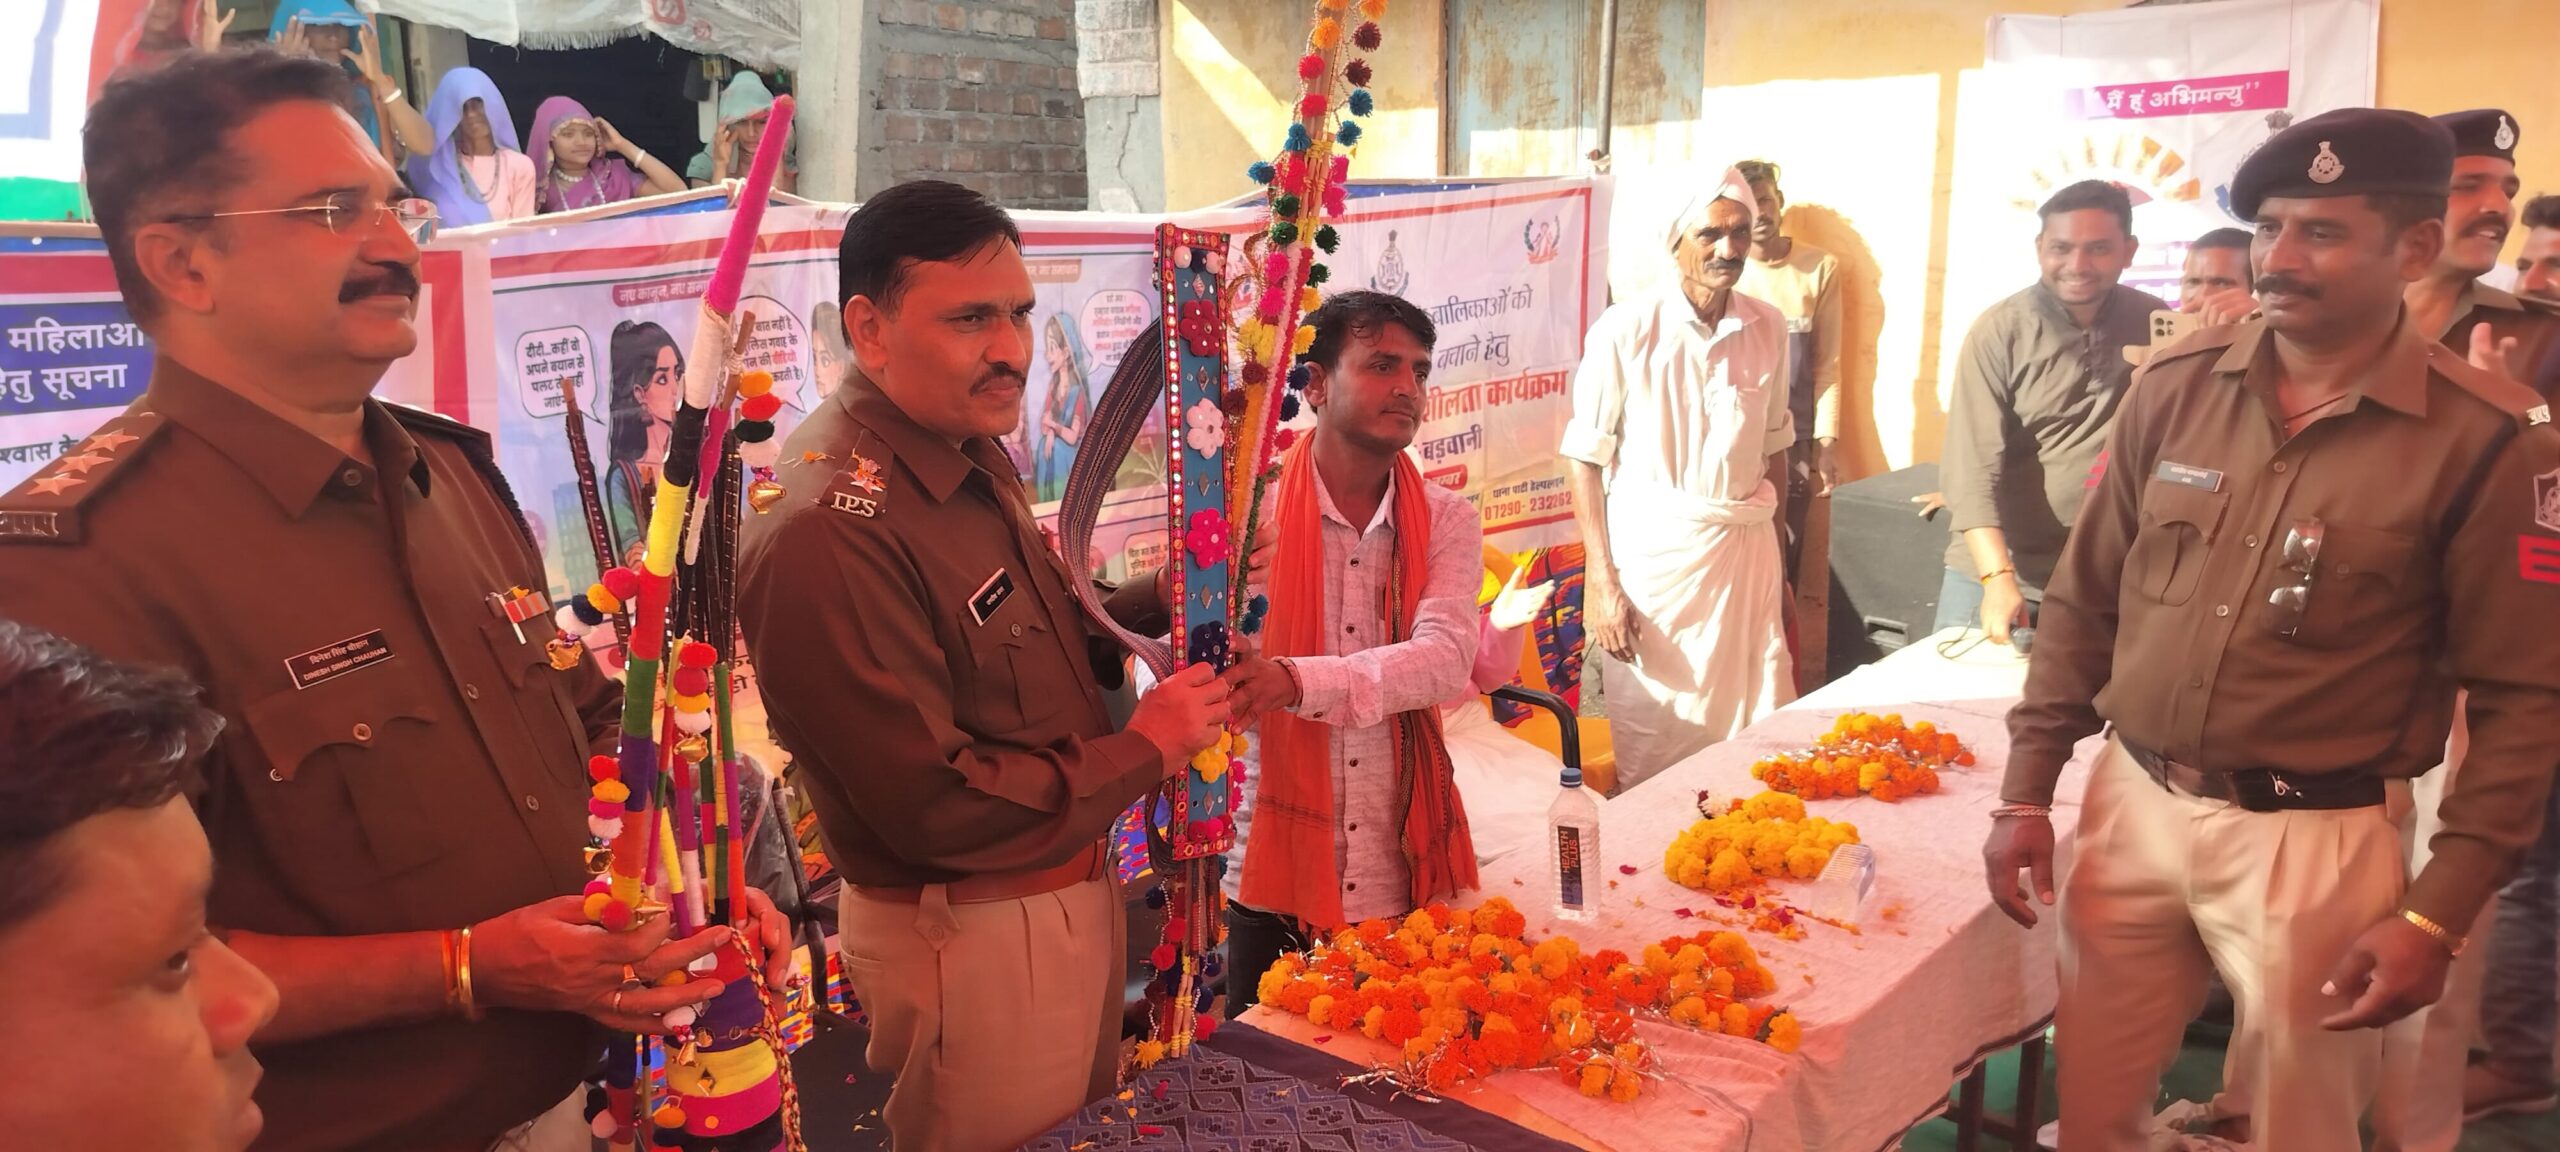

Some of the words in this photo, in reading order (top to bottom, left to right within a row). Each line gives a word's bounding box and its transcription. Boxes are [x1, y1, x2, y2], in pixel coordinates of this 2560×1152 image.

[1511, 283, 1533, 311] को
[1484, 331, 1511, 368] हेतु
[41, 363, 128, 400] सूचना
[1486, 366, 1569, 407] कार्यक्रम
[1560, 830, 1570, 874] HEALTH
[1569, 839, 1578, 868] PLUS
